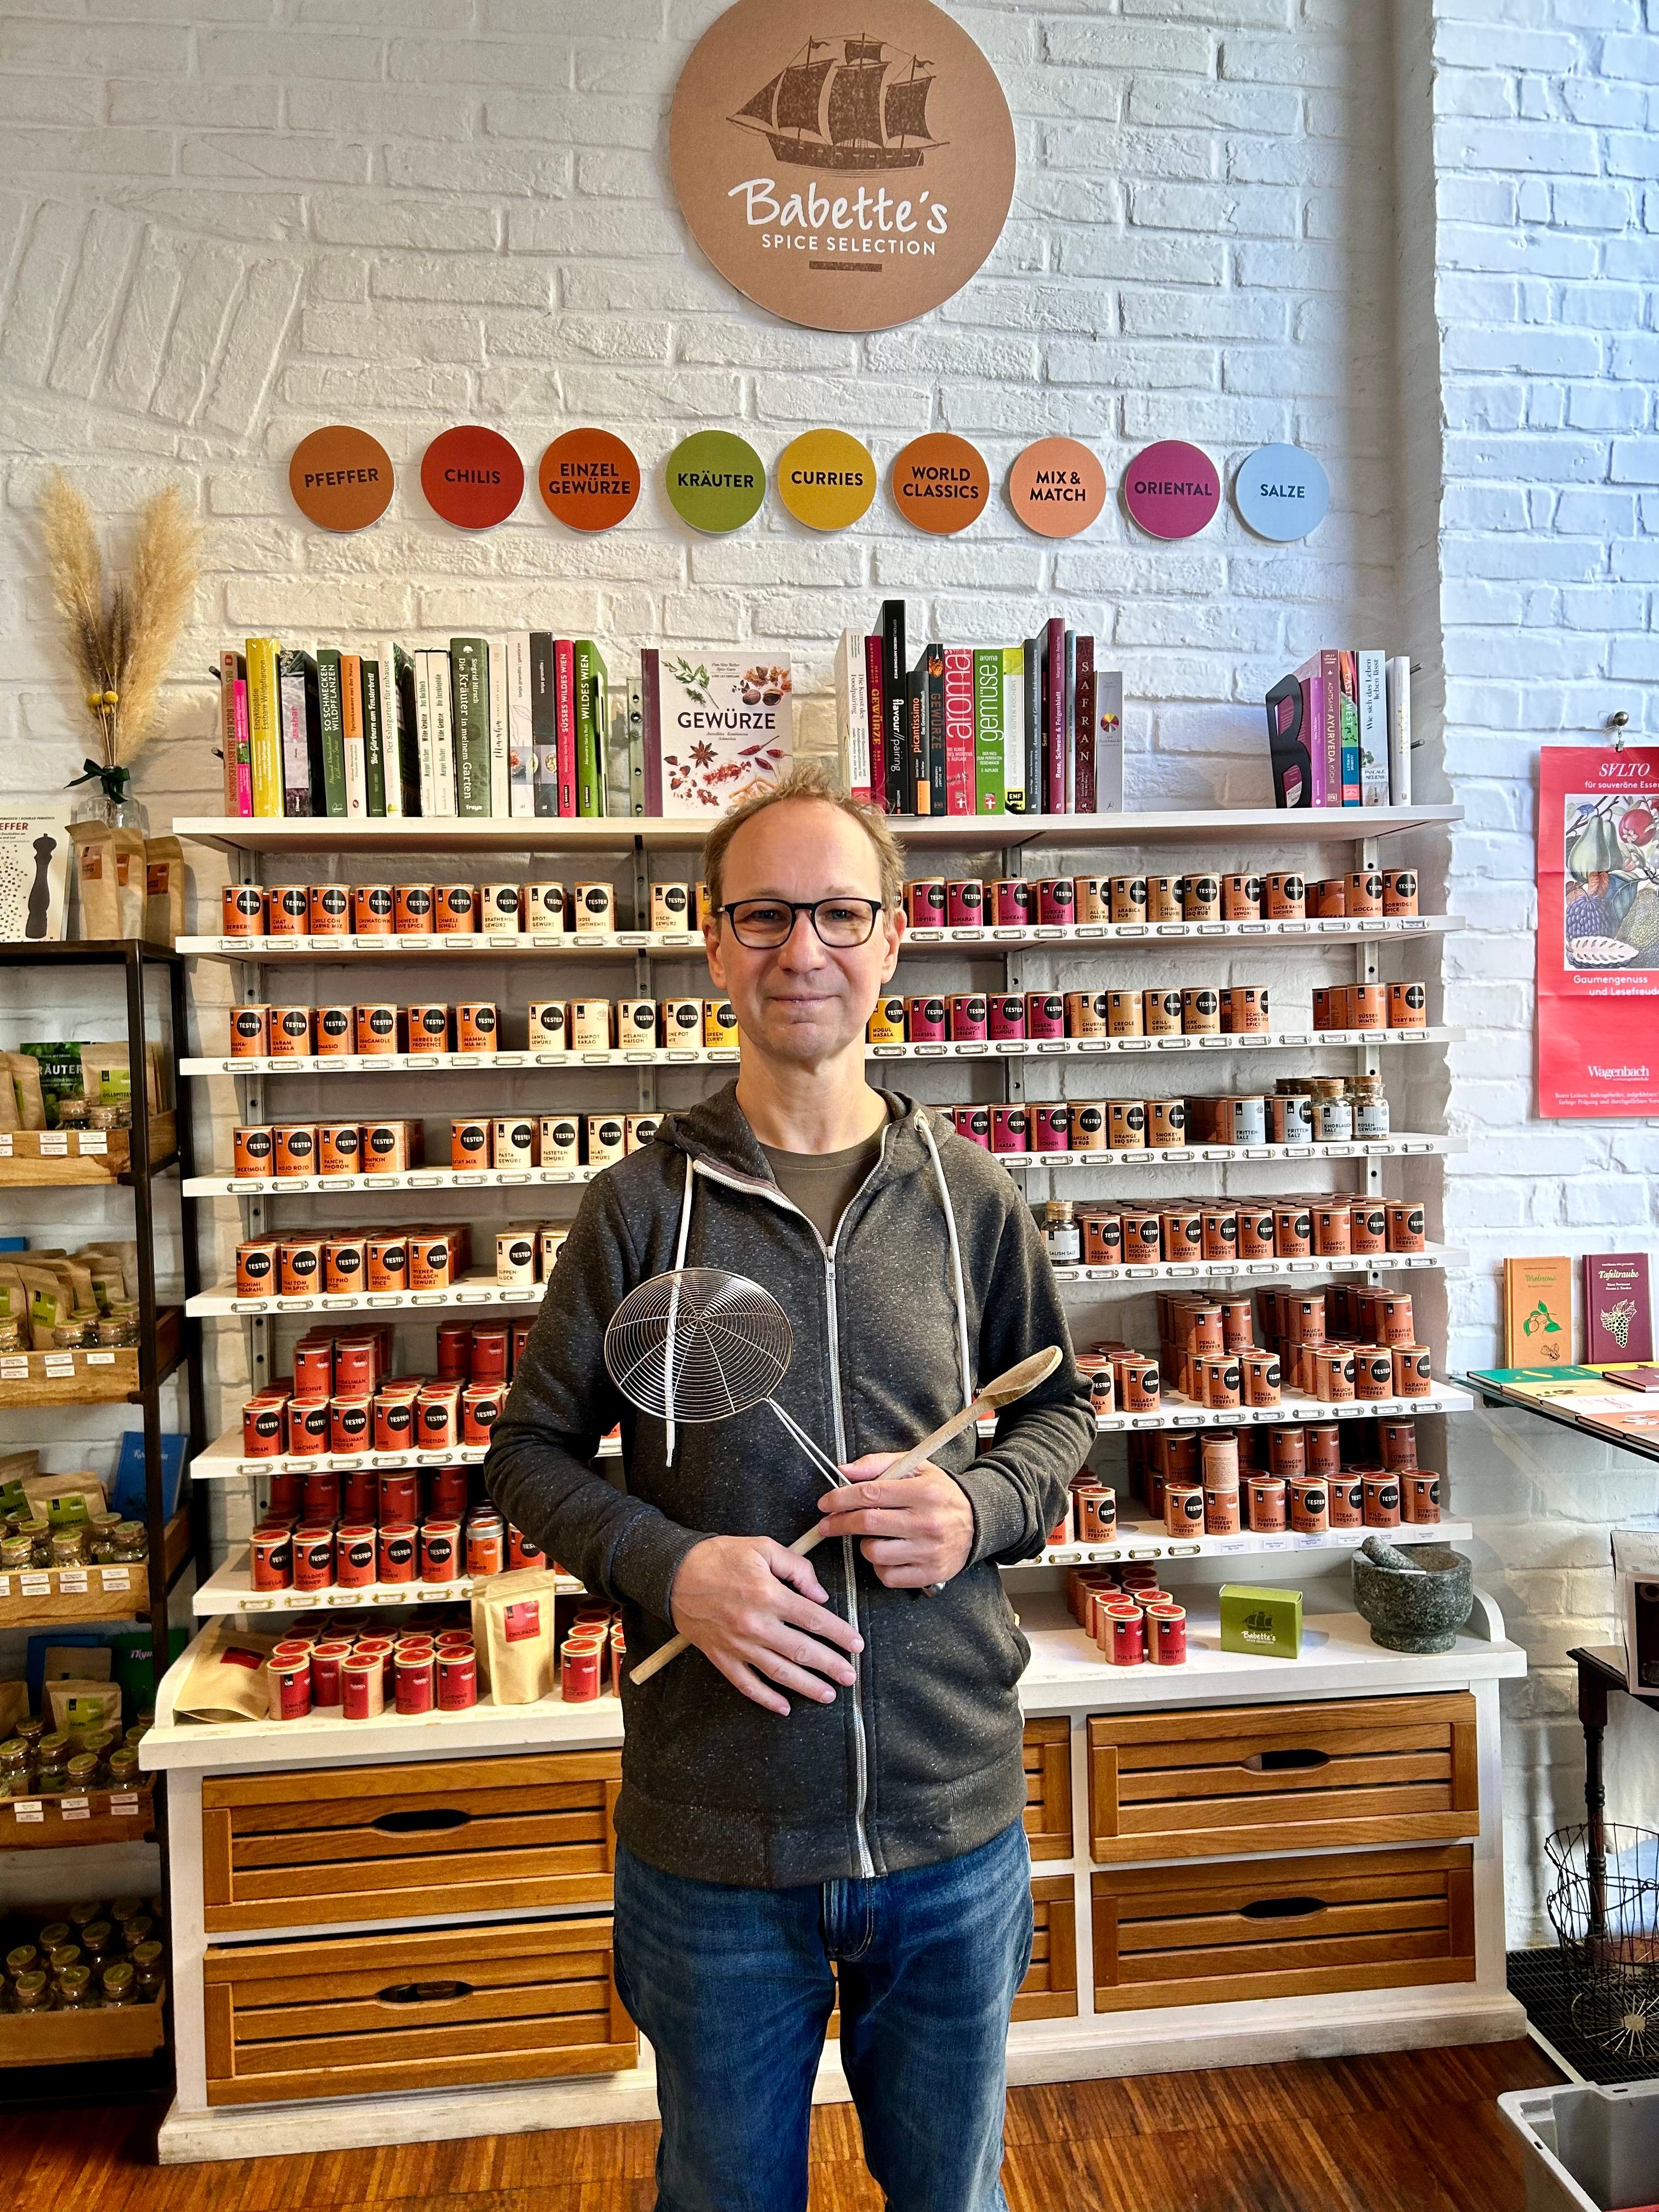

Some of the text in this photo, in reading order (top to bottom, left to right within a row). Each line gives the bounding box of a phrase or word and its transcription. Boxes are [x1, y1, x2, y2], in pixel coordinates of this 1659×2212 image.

[728, 178, 949, 234] Babette's
[761, 234, 936, 256] SPICE SELECTION
[304, 467, 379, 488] PFEFFER
[444, 469, 501, 485] CHILIS
[560, 462, 619, 477] EINZEL
[677, 470, 755, 489] KRÄUTER
[791, 471, 864, 486] CURRIES
[911, 466, 972, 482] WORLD
[1036, 471, 1081, 484] MIX &
[548, 477, 631, 495] GEWÜRZE
[902, 482, 979, 499] CLASSICS
[1029, 487, 1087, 501] MATCH
[1134, 481, 1212, 496] ORIENTAL
[1261, 484, 1305, 498] SALZE
[580, 654, 589, 681] WIEN
[259, 660, 268, 703] Wildpflanzen
[320, 664, 332, 731] SO SCHMECKEN
[328, 664, 340, 731] WILDPFLANZEN
[458, 672, 469, 715] Kräuter
[582, 683, 590, 720] WILDES
[850, 674, 859, 715] Foodpairing
[945, 653, 973, 739] aroma
[979, 664, 1003, 742] gemüse
[260, 704, 269, 730] Essbare
[368, 673, 379, 765] Bio-Gärtnern am Fensterbrett
[385, 701, 394, 740] Salatgarten
[461, 717, 467, 726] in
[560, 704, 569, 733] SÜSSES
[678, 708, 776, 730] GEWÜRZE
[871, 689, 882, 745] GEWÜRZE
[911, 697, 922, 753] picantissimo
[930, 693, 943, 750] GEWÜRZE
[1327, 714, 1336, 764] AYURVEDA
[228, 740, 236, 802] SELBSTVERSORGUNG
[462, 761, 472, 799] Garten
[1573, 975, 1648, 986] Gaumengenuss
[1589, 988, 1607, 996] und
[39, 1064, 82, 1075] RÄUTER
[1587, 1065, 1650, 1080] Wagenbach
[1598, 1268, 1639, 1281] Tafeltraube
[1241, 1629, 1277, 1642] Babette's
